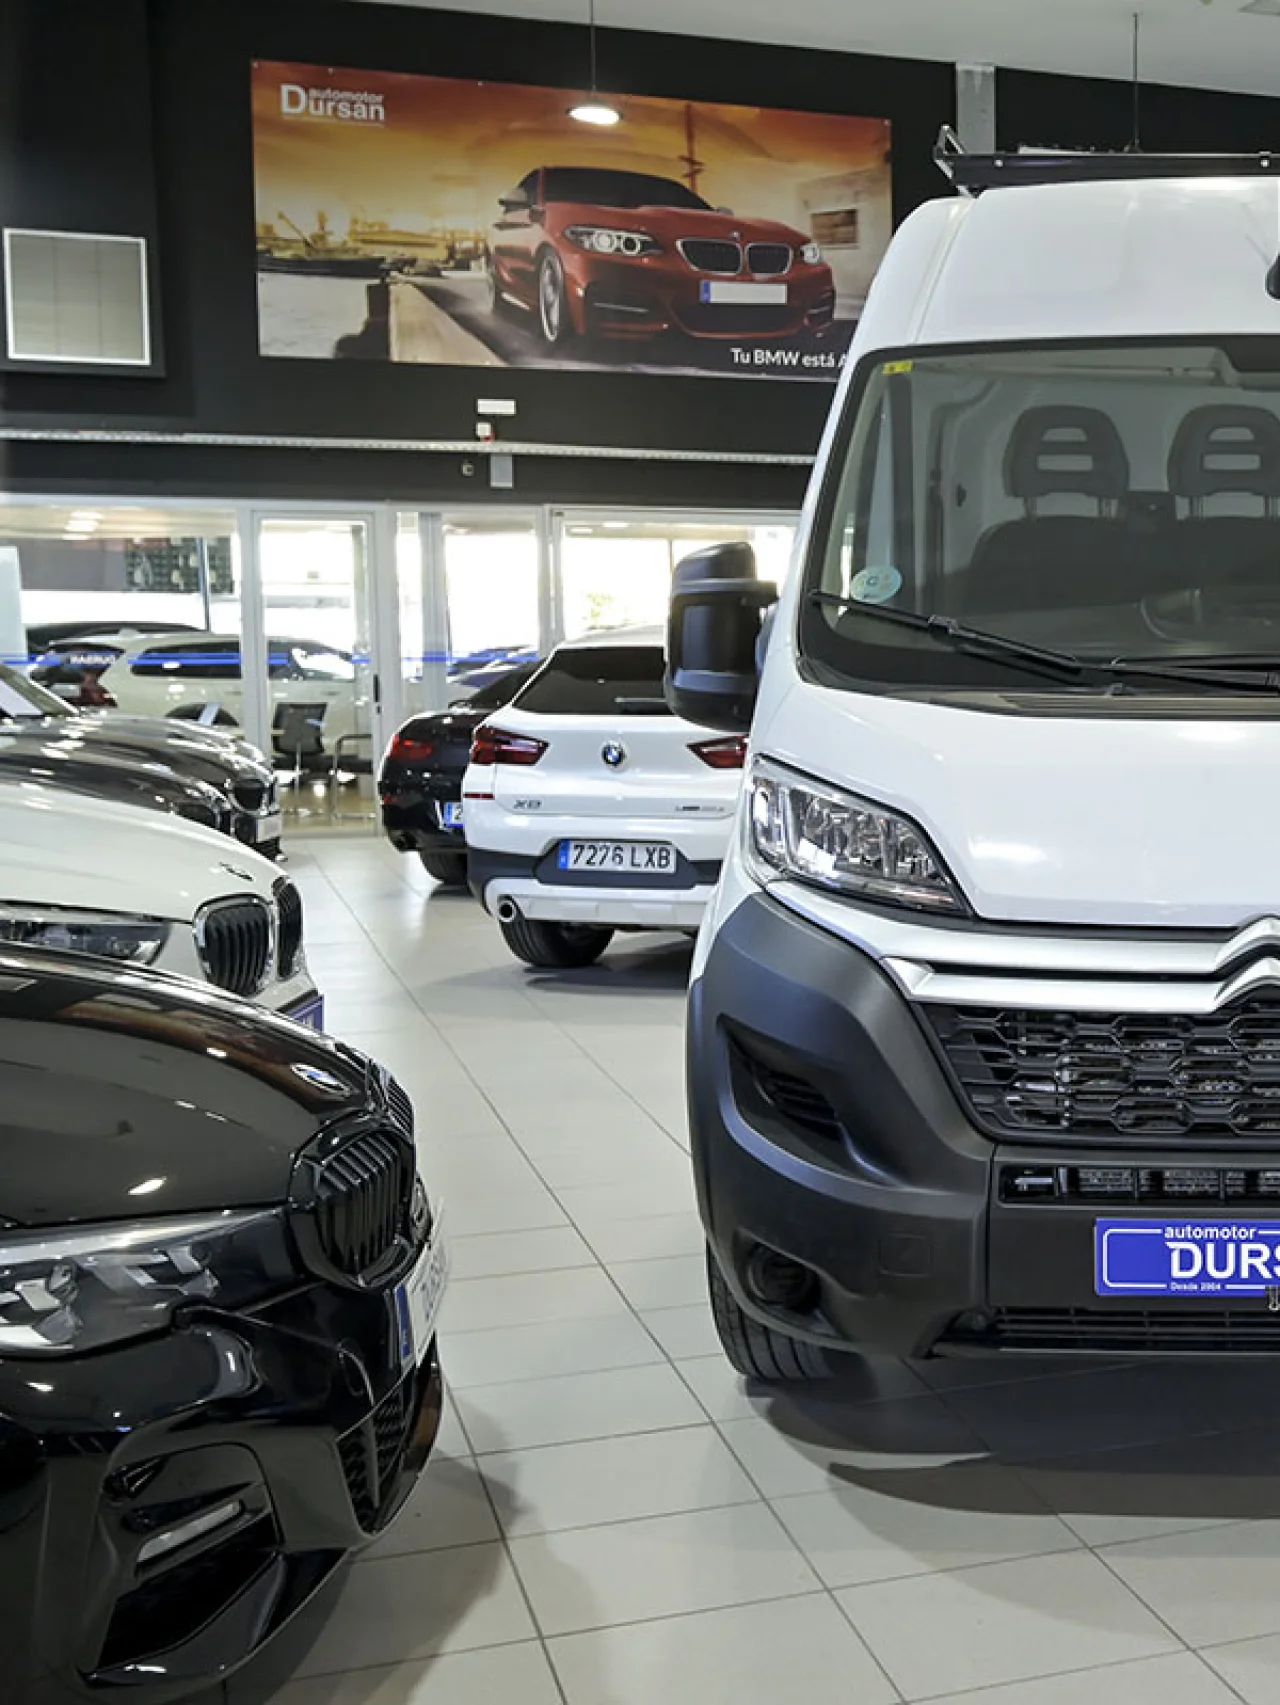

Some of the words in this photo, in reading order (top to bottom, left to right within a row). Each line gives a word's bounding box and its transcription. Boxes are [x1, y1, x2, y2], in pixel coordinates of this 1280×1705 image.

[281, 84, 385, 121] Dursan
[730, 347, 750, 364] Tu
[754, 349, 800, 366] BMW
[802, 352, 835, 368] está
[573, 844, 624, 867] 7276
[630, 846, 671, 869] LXB
[1164, 1225, 1257, 1240] automotor
